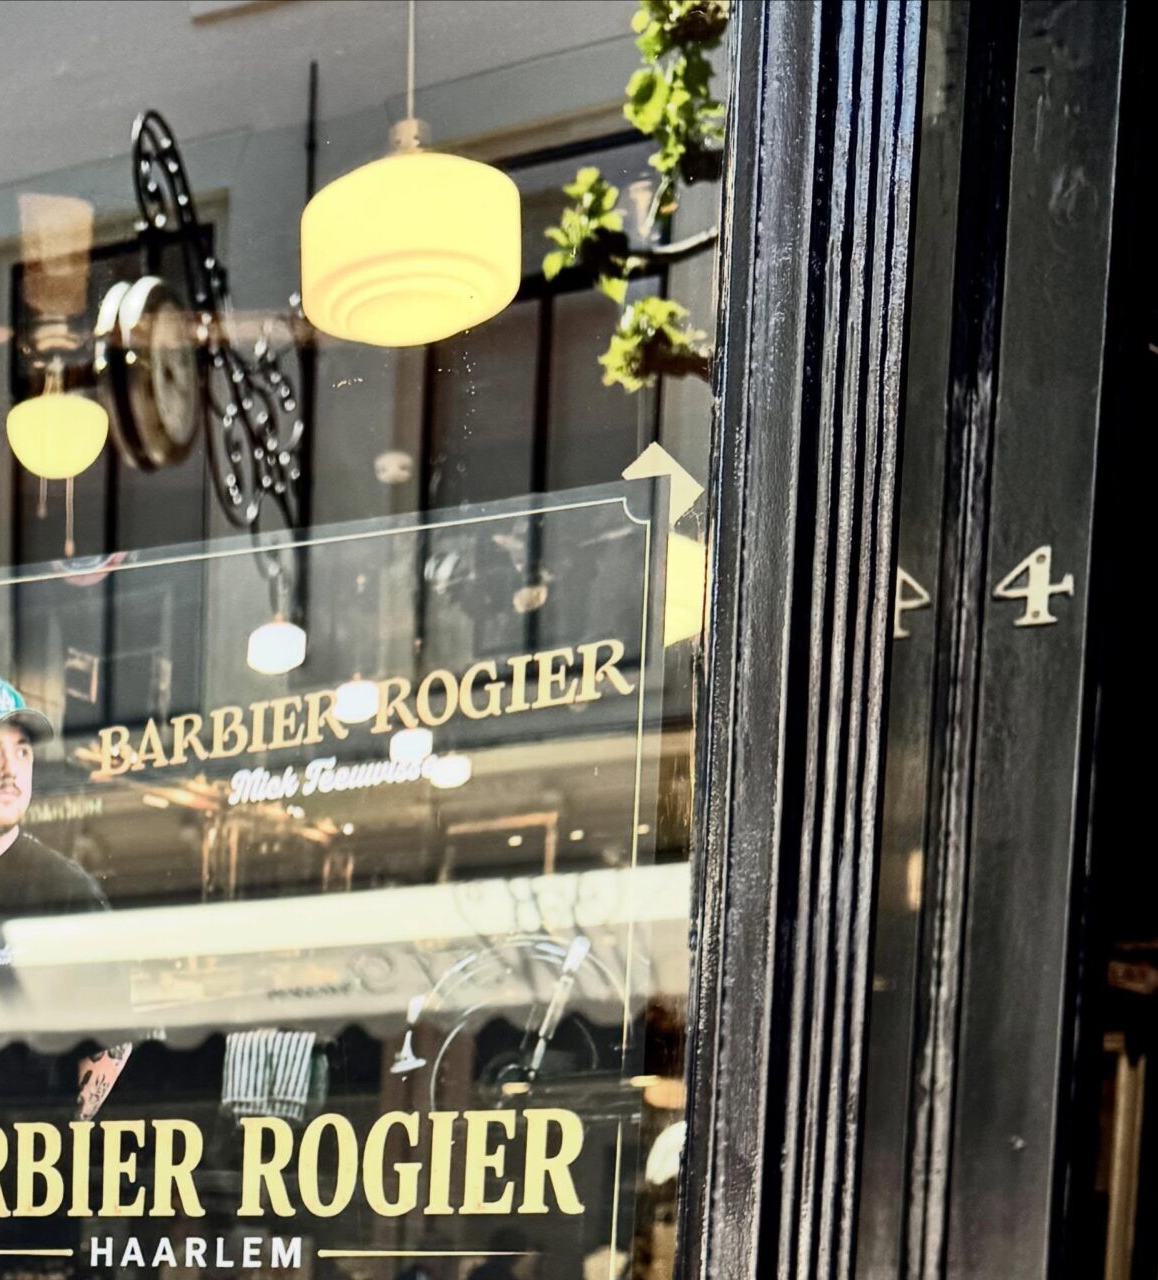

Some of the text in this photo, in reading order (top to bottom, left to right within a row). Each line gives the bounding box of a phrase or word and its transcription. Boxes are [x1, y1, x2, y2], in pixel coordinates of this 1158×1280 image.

[994, 545, 1074, 626] 4
[94, 639, 634, 776] BARBIER ROGIER
[228, 765, 299, 806] Mick
[237, 1107, 585, 1217] ROGIER
[89, 1236, 303, 1268] HAARLEM
